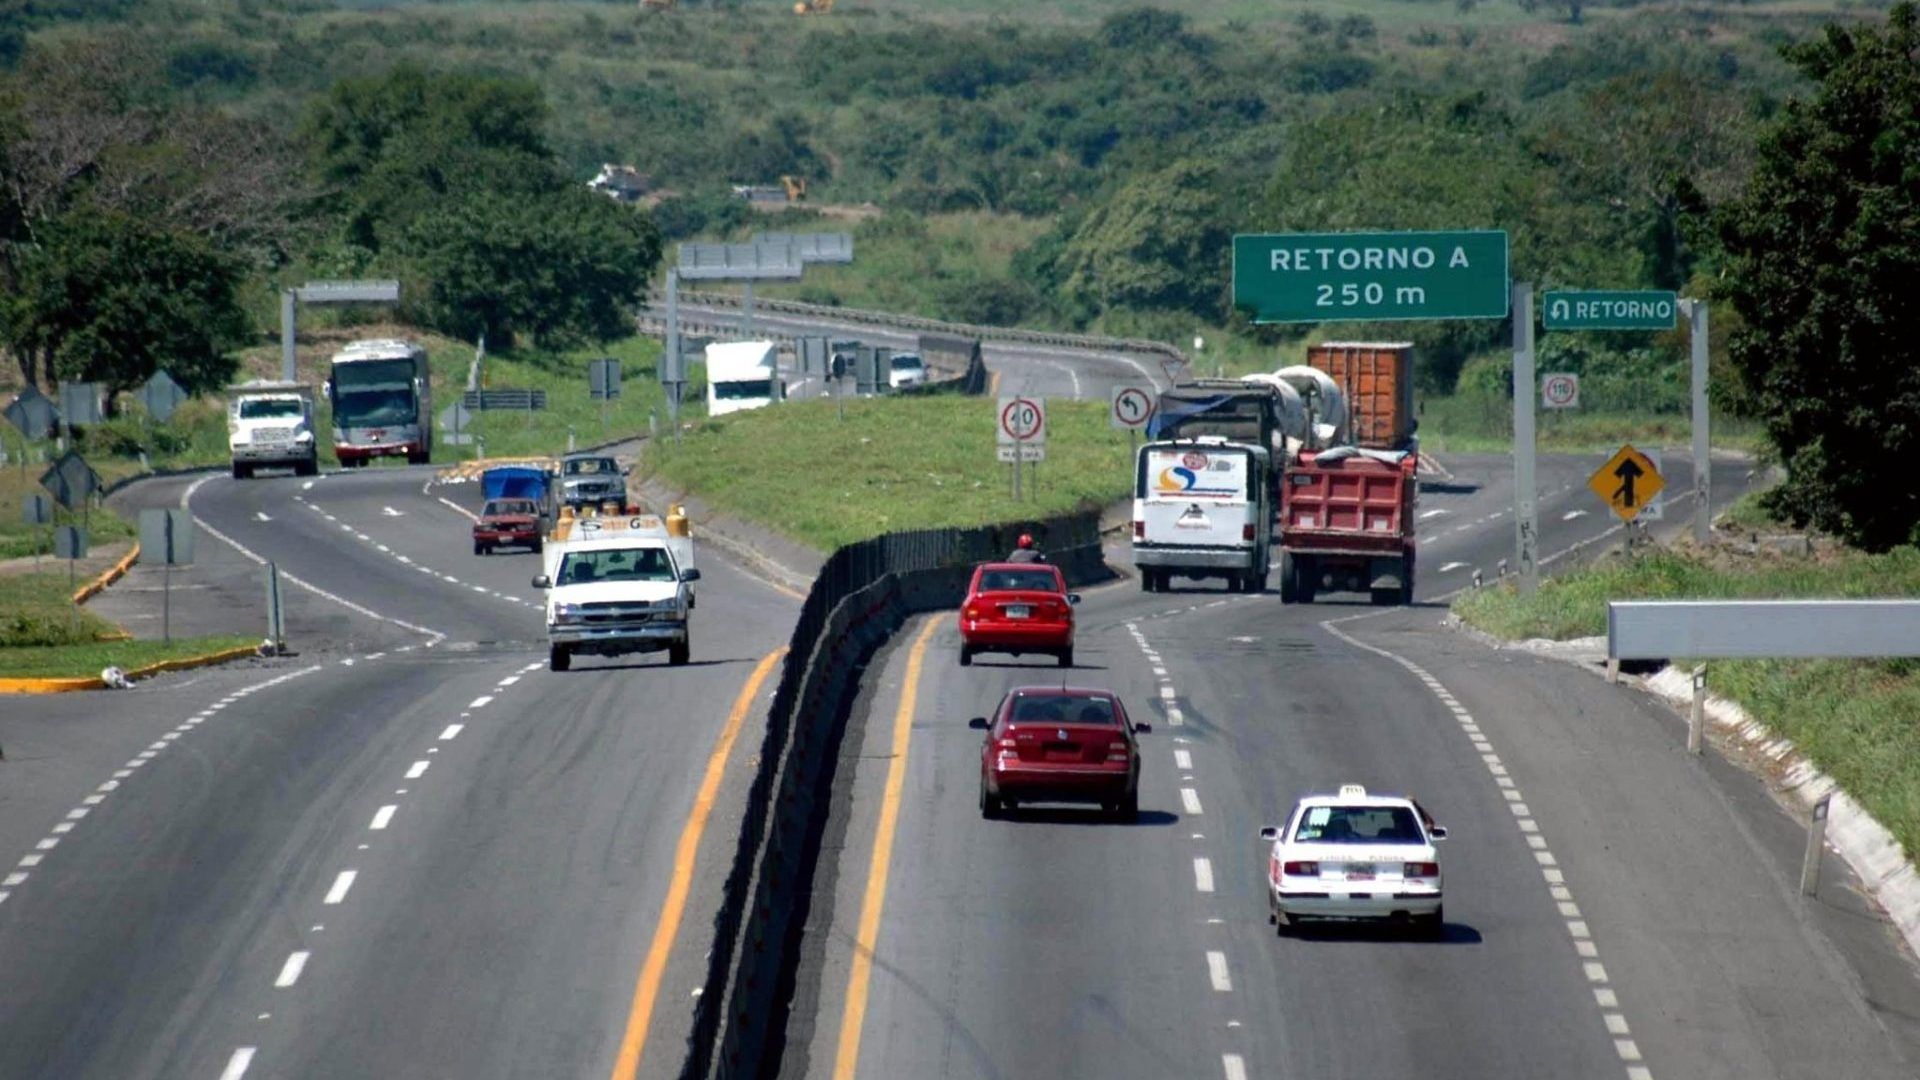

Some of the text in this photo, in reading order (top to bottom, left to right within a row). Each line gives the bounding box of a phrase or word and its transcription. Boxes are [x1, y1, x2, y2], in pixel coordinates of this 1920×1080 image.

[1270, 246, 1469, 271] RETORNO A
[1316, 282, 1425, 306] 250 m
[1576, 301, 1671, 318] RETORNO
